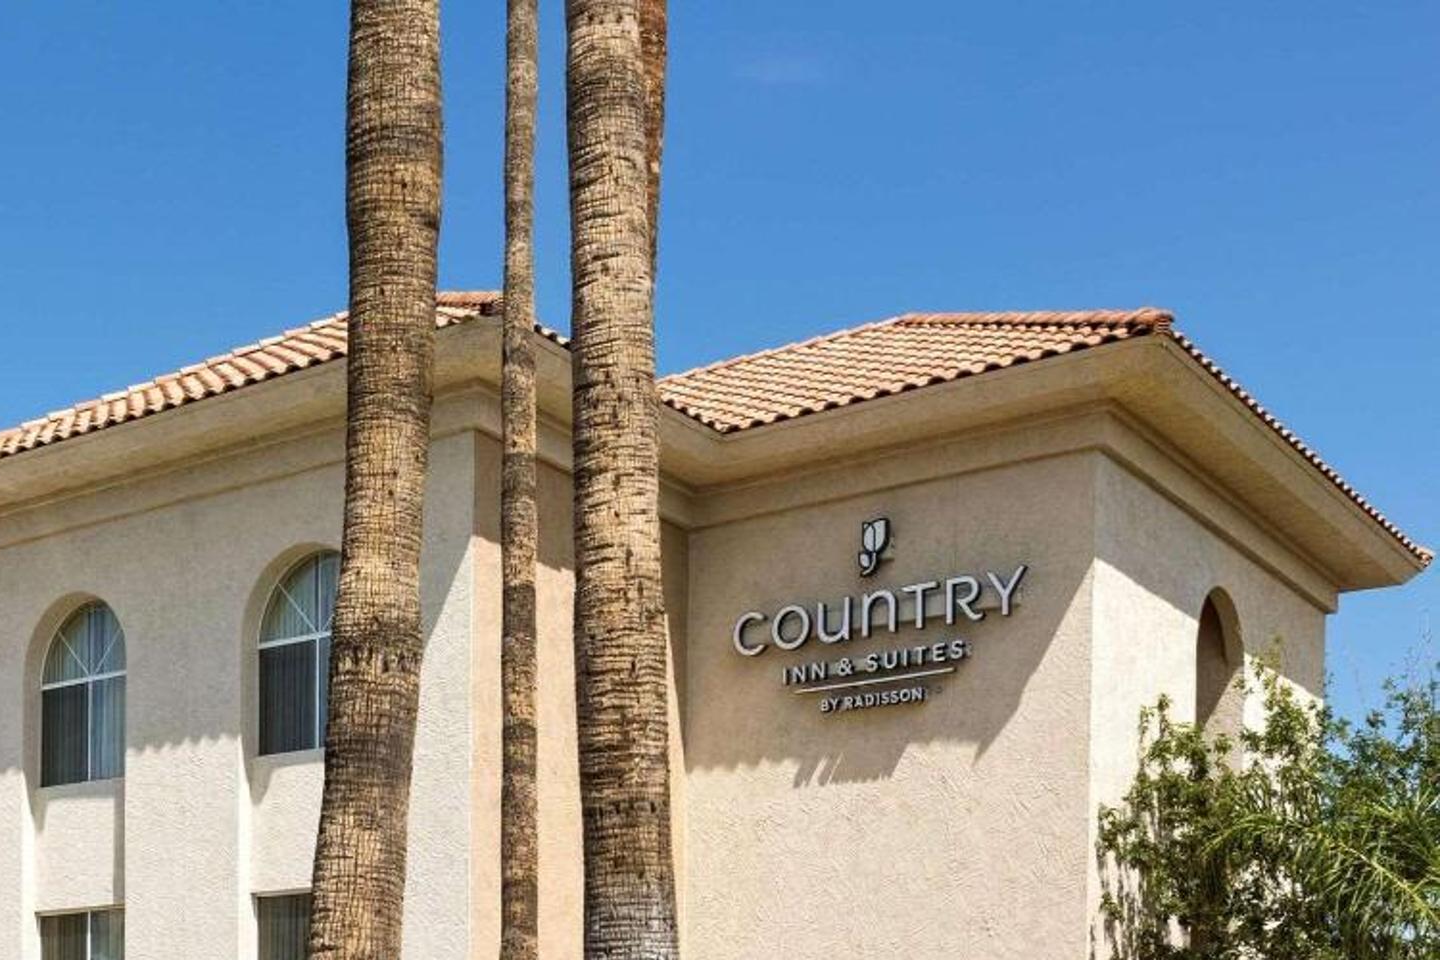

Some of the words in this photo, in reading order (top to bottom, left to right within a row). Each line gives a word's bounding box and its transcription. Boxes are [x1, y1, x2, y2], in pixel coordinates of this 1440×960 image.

[732, 565, 1028, 656] COUNTRY
[782, 661, 827, 685] INN
[836, 657, 854, 677] &
[864, 639, 965, 673] SUITES
[820, 698, 842, 713] BY
[843, 686, 924, 712] RADISSON
